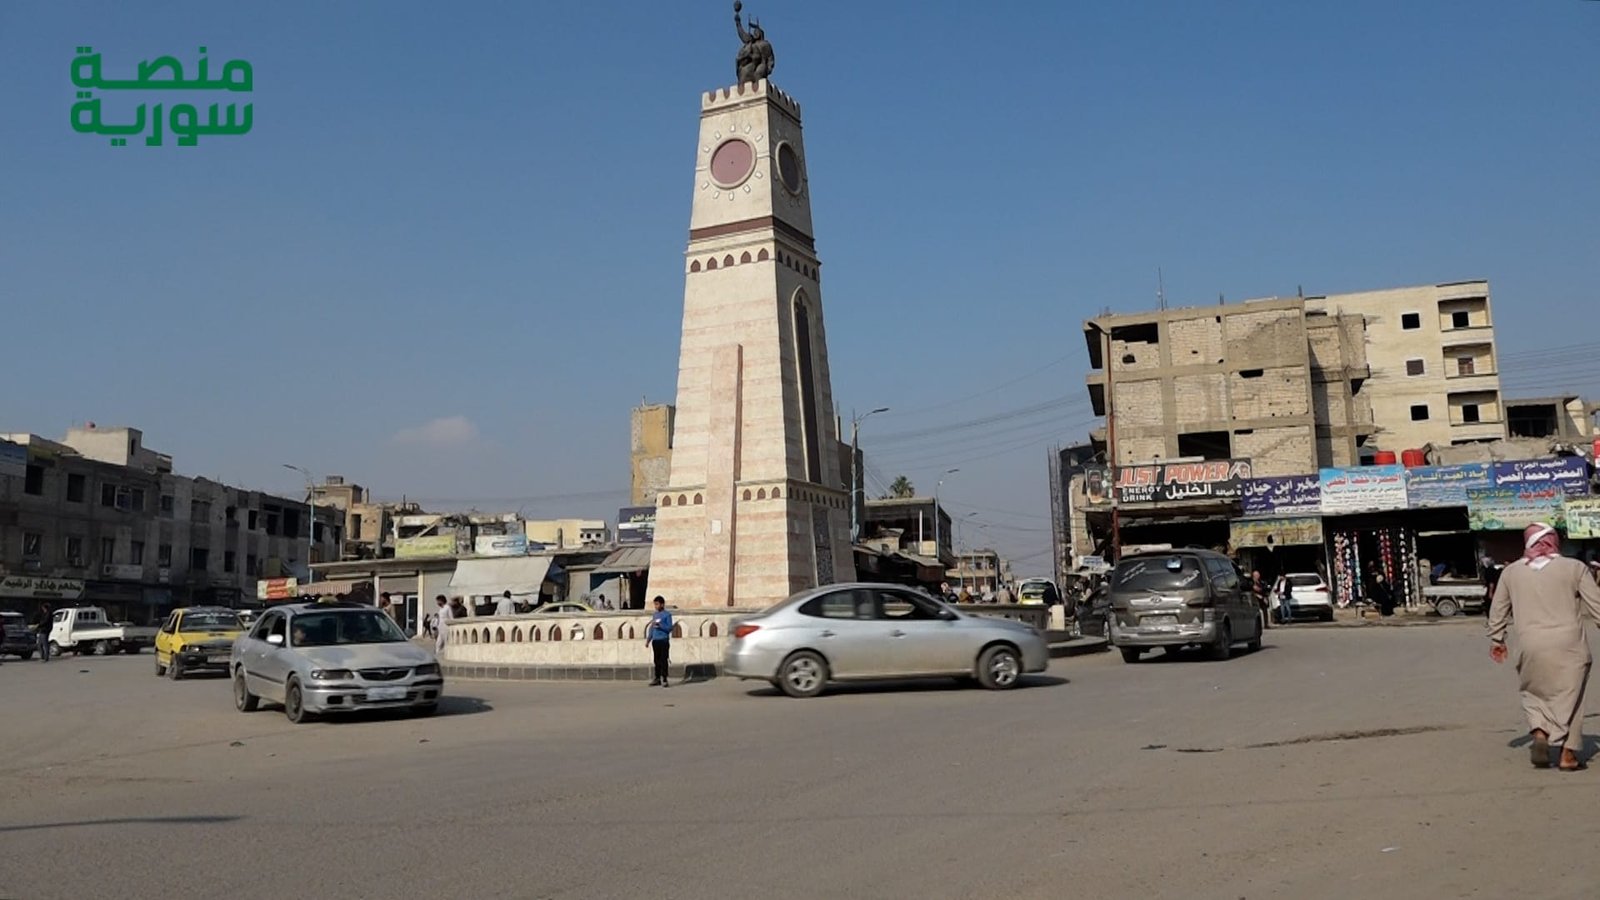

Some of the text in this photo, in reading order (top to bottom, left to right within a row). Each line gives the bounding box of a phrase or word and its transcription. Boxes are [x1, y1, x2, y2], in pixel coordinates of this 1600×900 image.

[1514, 462, 1538, 471] الجراح
[1117, 461, 1230, 488] JUST POWER
[1496, 471, 1524, 484] الحسن
[1525, 471, 1550, 480] محمد
[1122, 486, 1161, 495] ENERGY
[1165, 483, 1212, 499] الخليل
[1244, 481, 1272, 496] حيان
[1275, 480, 1293, 494] ابن
[1122, 494, 1153, 503] DRINK
